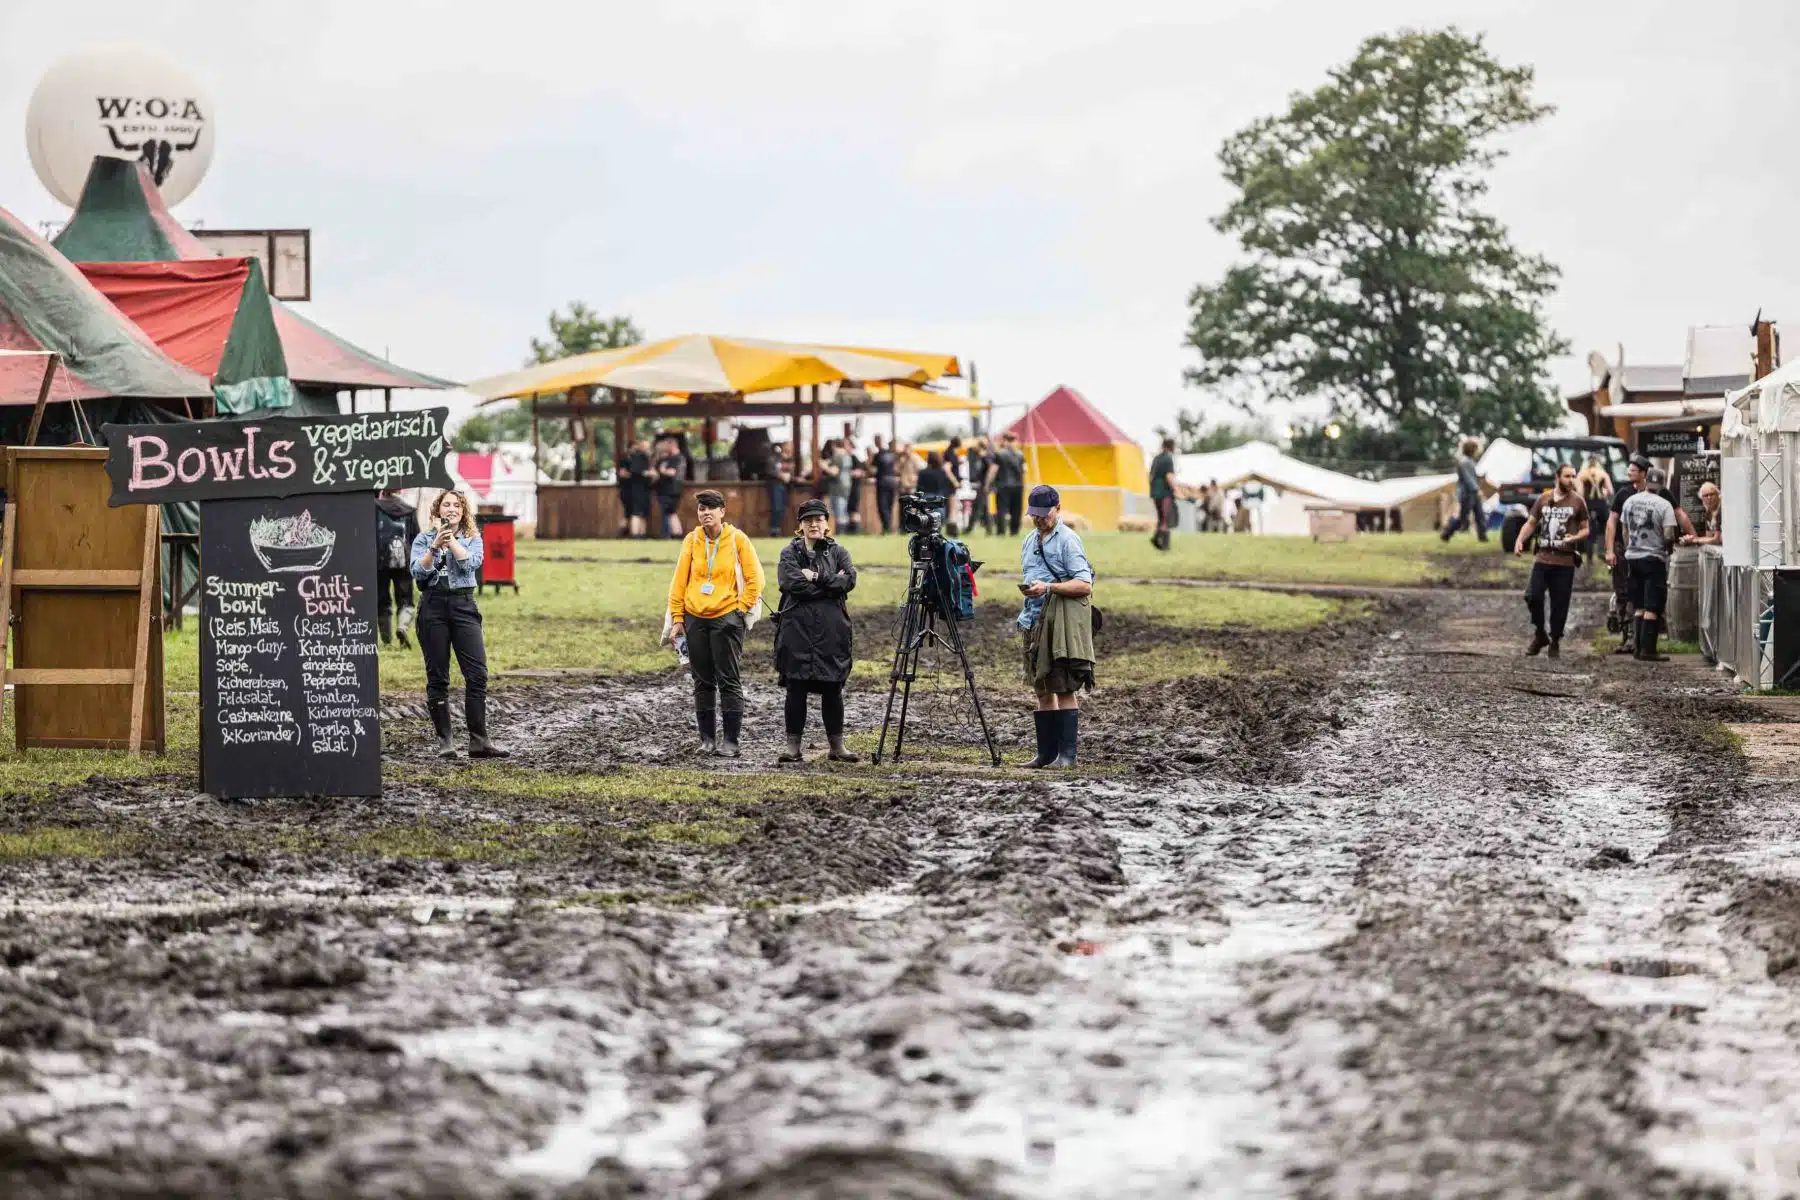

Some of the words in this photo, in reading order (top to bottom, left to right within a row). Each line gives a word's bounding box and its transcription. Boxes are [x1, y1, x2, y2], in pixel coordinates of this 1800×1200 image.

[97, 98, 204, 121] W:O:A
[301, 409, 438, 456] vegetarisch
[128, 427, 296, 492] Bowls
[312, 447, 337, 485] &
[344, 453, 414, 489] vegan
[206, 575, 286, 598] Summer-
[298, 574, 363, 599] Chili-
[218, 595, 267, 615] bowl
[305, 597, 355, 615] bowl
[250, 616, 281, 636] Mais,
[336, 616, 372, 636] Mais,
[304, 688, 359, 704] Tomaten,
[308, 720, 350, 741] Paprika
[353, 719, 366, 736] &
